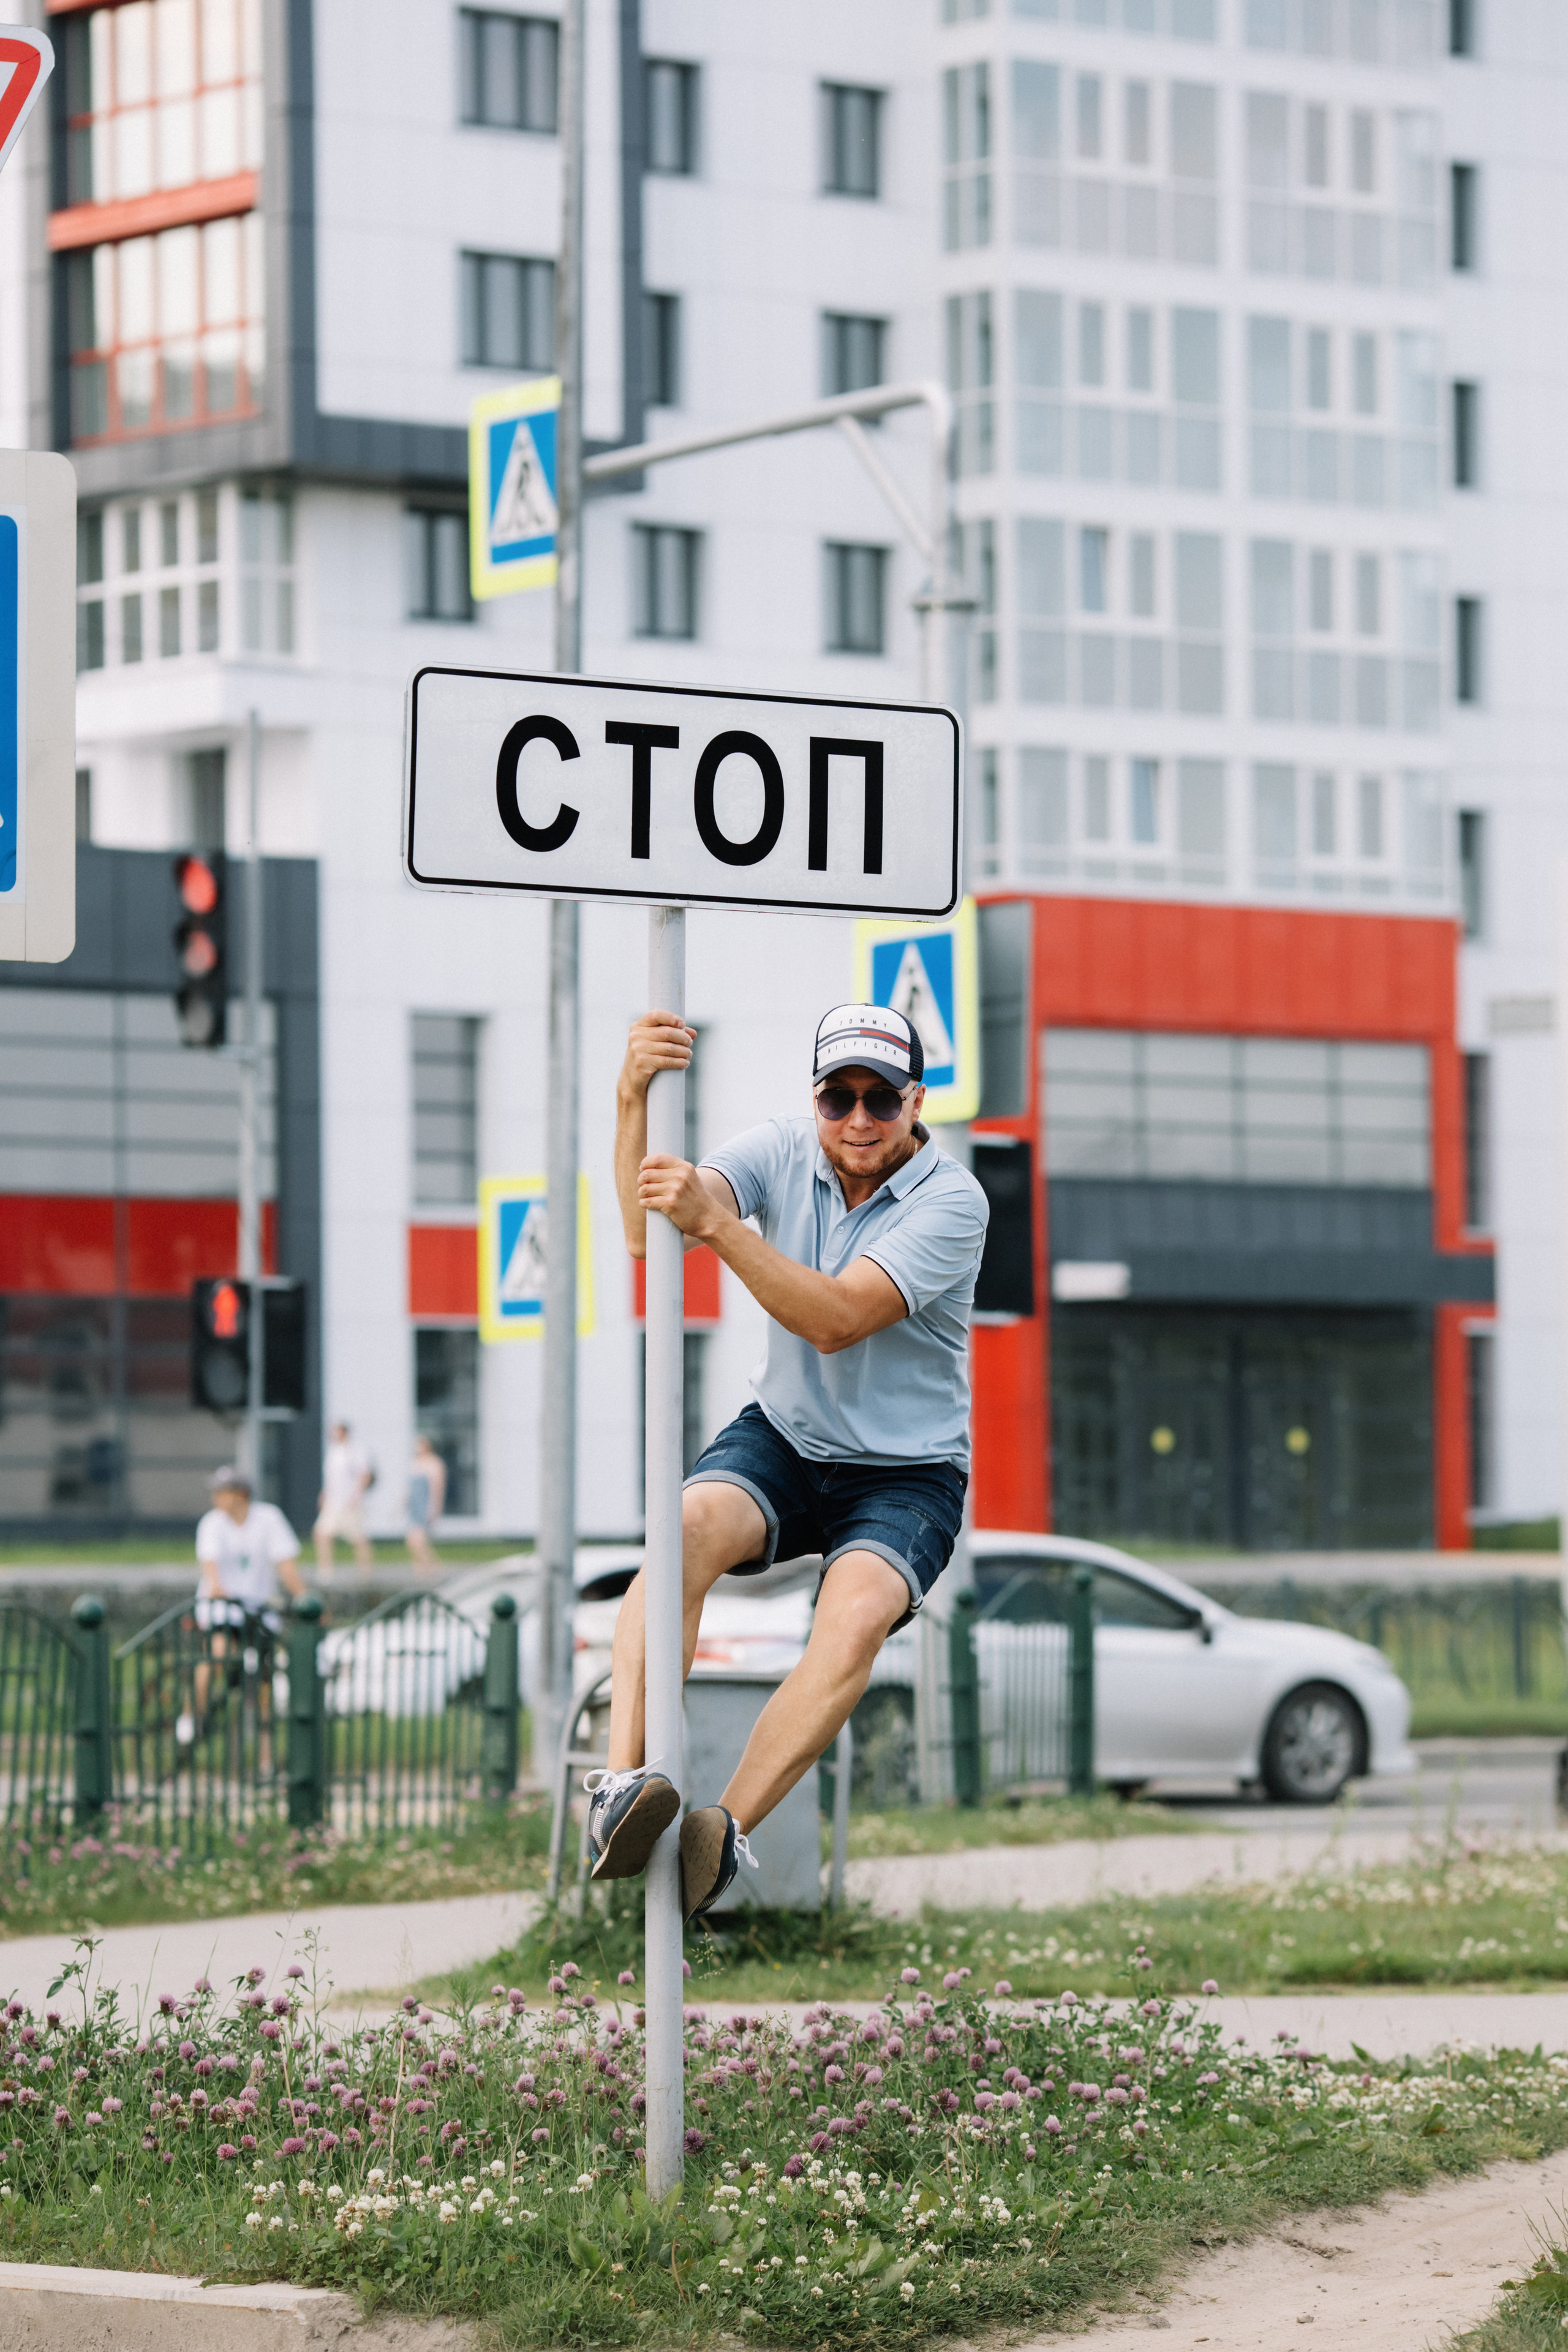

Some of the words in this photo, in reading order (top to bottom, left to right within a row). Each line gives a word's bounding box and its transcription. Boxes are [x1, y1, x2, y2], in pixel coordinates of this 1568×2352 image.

[497, 715, 883, 874] СТОП
[840, 1018, 887, 1028] TOMMY
[827, 1041, 897, 1055] HILFIGER
